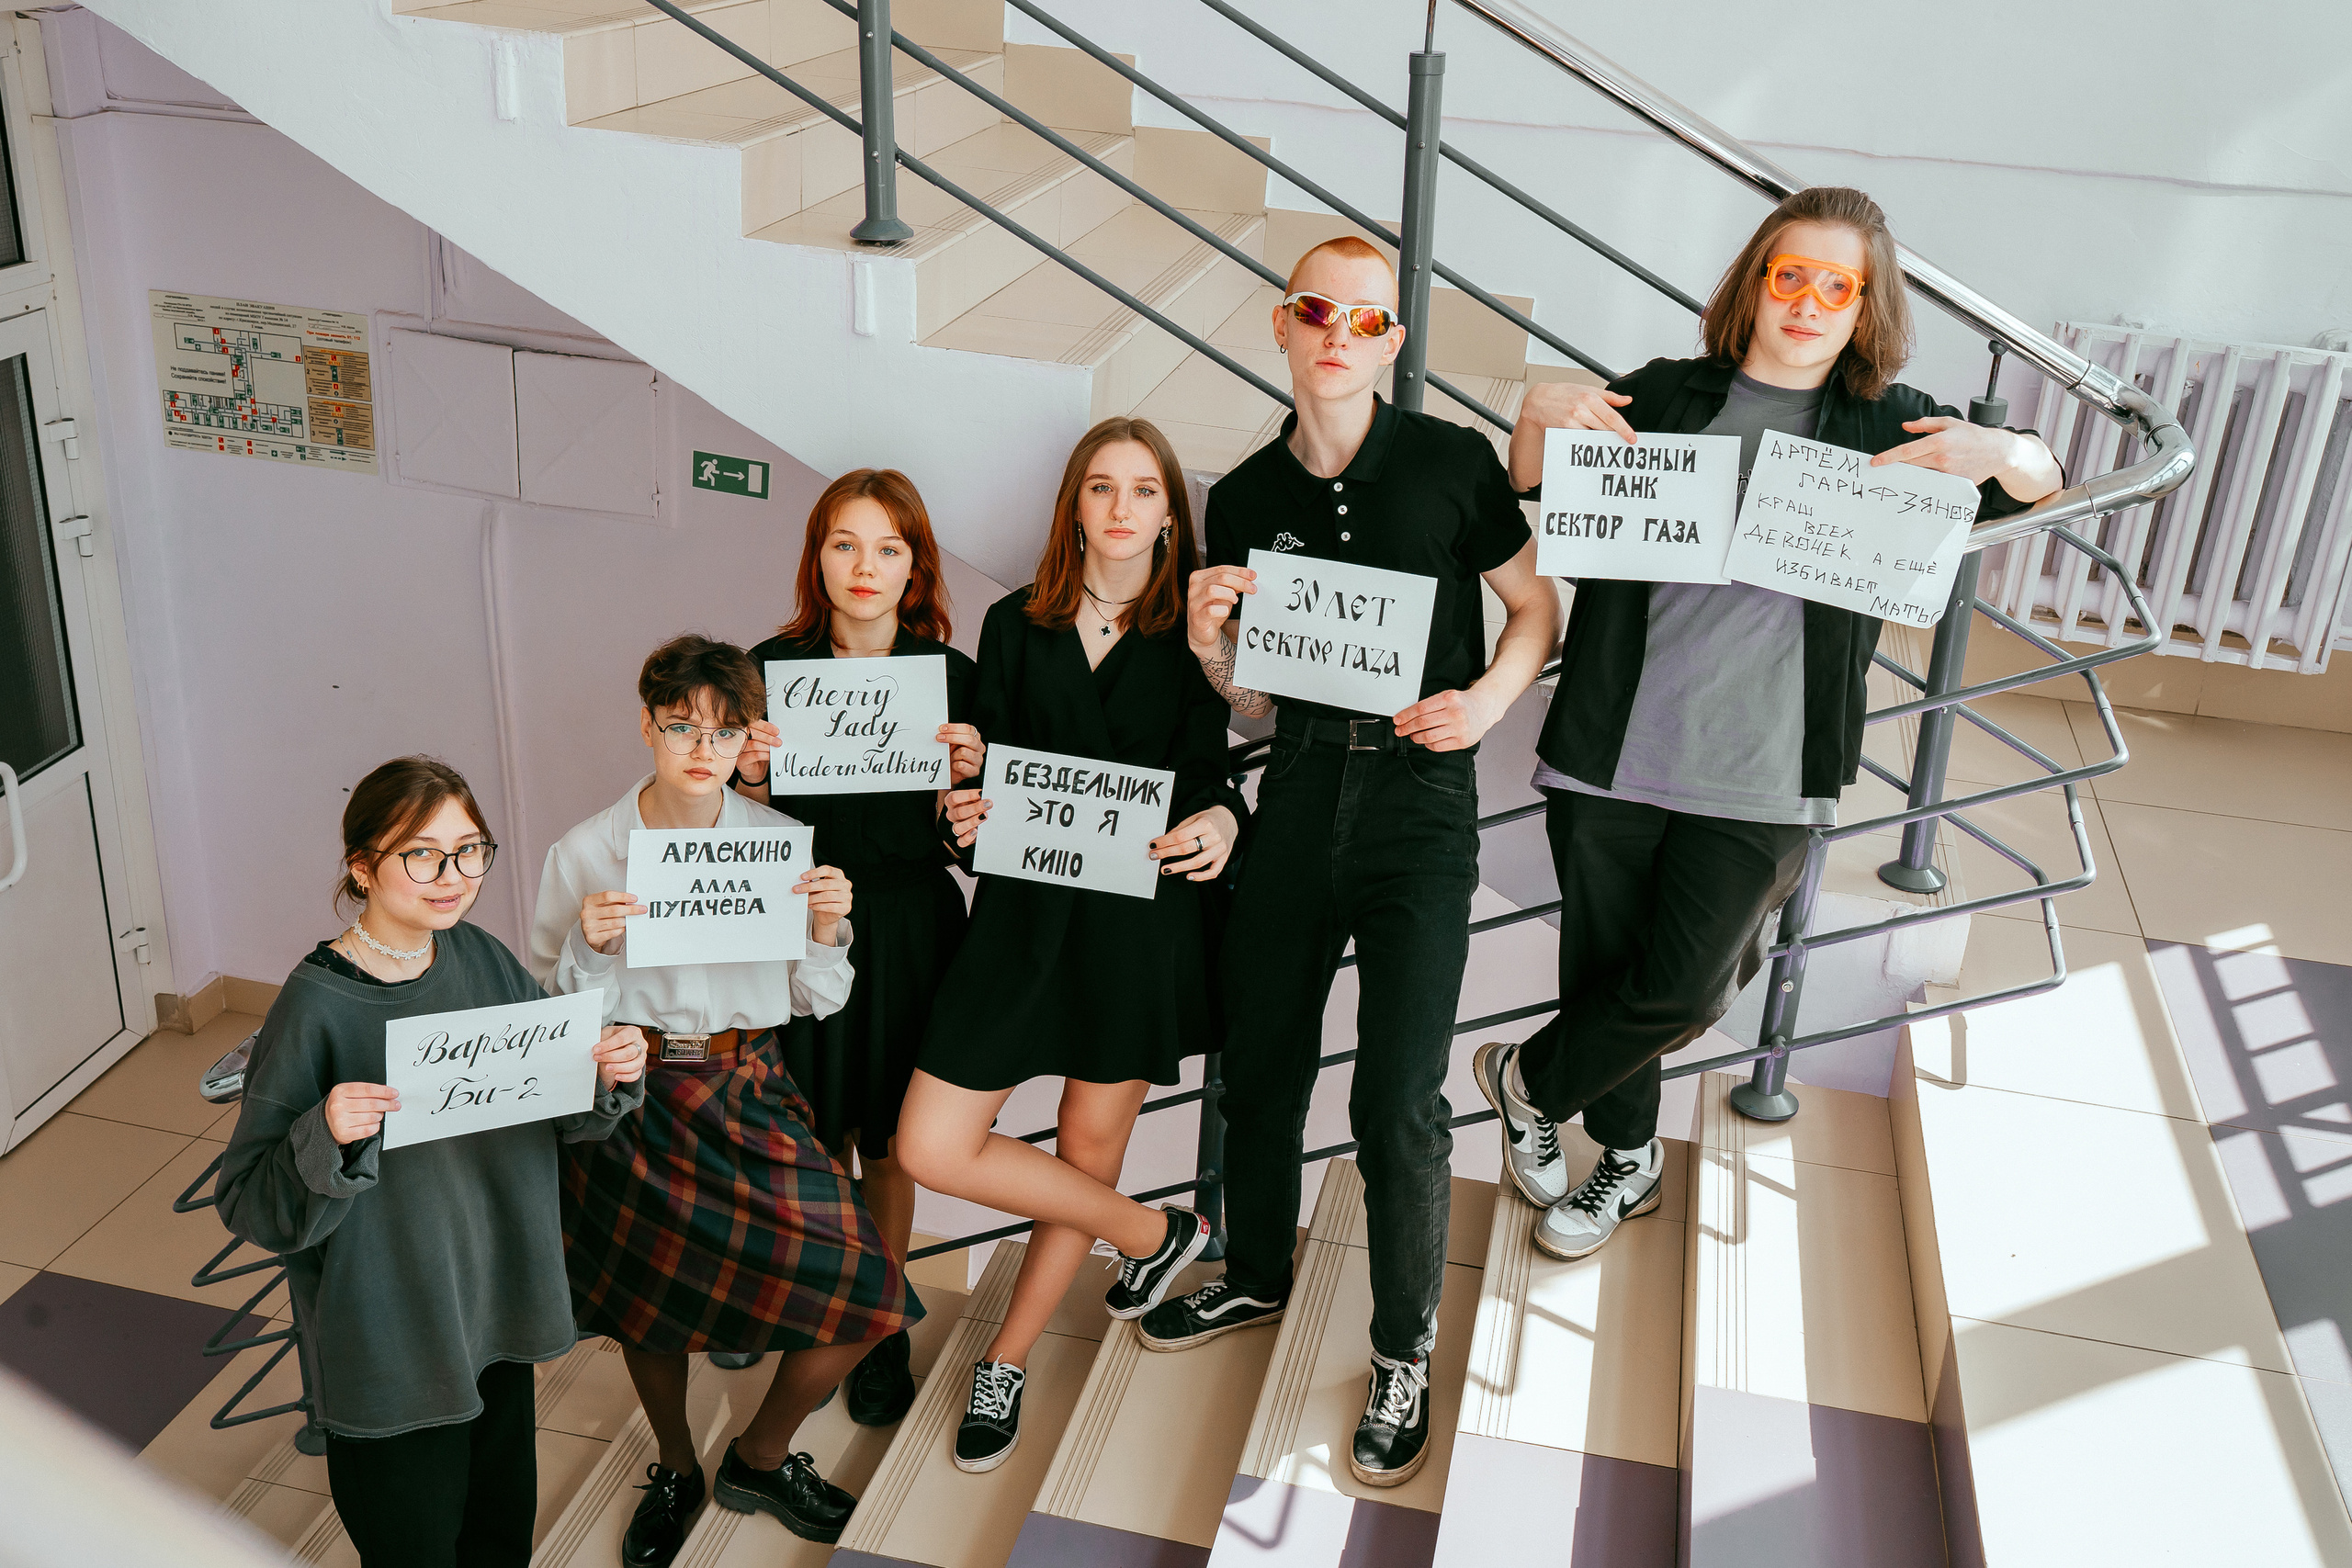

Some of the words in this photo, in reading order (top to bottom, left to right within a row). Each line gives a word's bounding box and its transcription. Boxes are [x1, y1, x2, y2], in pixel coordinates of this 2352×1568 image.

[1570, 443, 1697, 473] КОЛХОЗНЫЙ
[1770, 440, 1860, 478] АРТЁМ
[1600, 474, 1658, 500] ПАНК
[1758, 492, 1814, 516] КРАШ
[1545, 512, 1623, 540] СЕКТОР
[1642, 517, 1702, 545] ГАЗА
[1743, 524, 1851, 560] ДЕВОЧЕК
[1872, 552, 1883, 565] А
[1804, 521, 1854, 538] ВСЕХ
[1776, 558, 1878, 594] ИЗБИВАЕТ
[1284, 577, 1320, 614] 30
[1324, 591, 1396, 627] ЛЕТ
[1246, 626, 1333, 666] СЕКТОР
[784, 674, 899, 718] Cherry
[823, 709, 910, 749] Lady
[775, 751, 856, 778] Modern
[860, 748, 943, 784] Talking
[1004, 759, 1165, 808] БЕЗДЕЛЬНИК
[1024, 796, 1075, 828] ЭТО
[1097, 809, 1120, 836] Я
[660, 840, 792, 863] АРЛЕКИНО
[1022, 845, 1083, 878] КИНО
[689, 878, 752, 894] АЛЛА
[413, 1018, 571, 1070] Варвара
